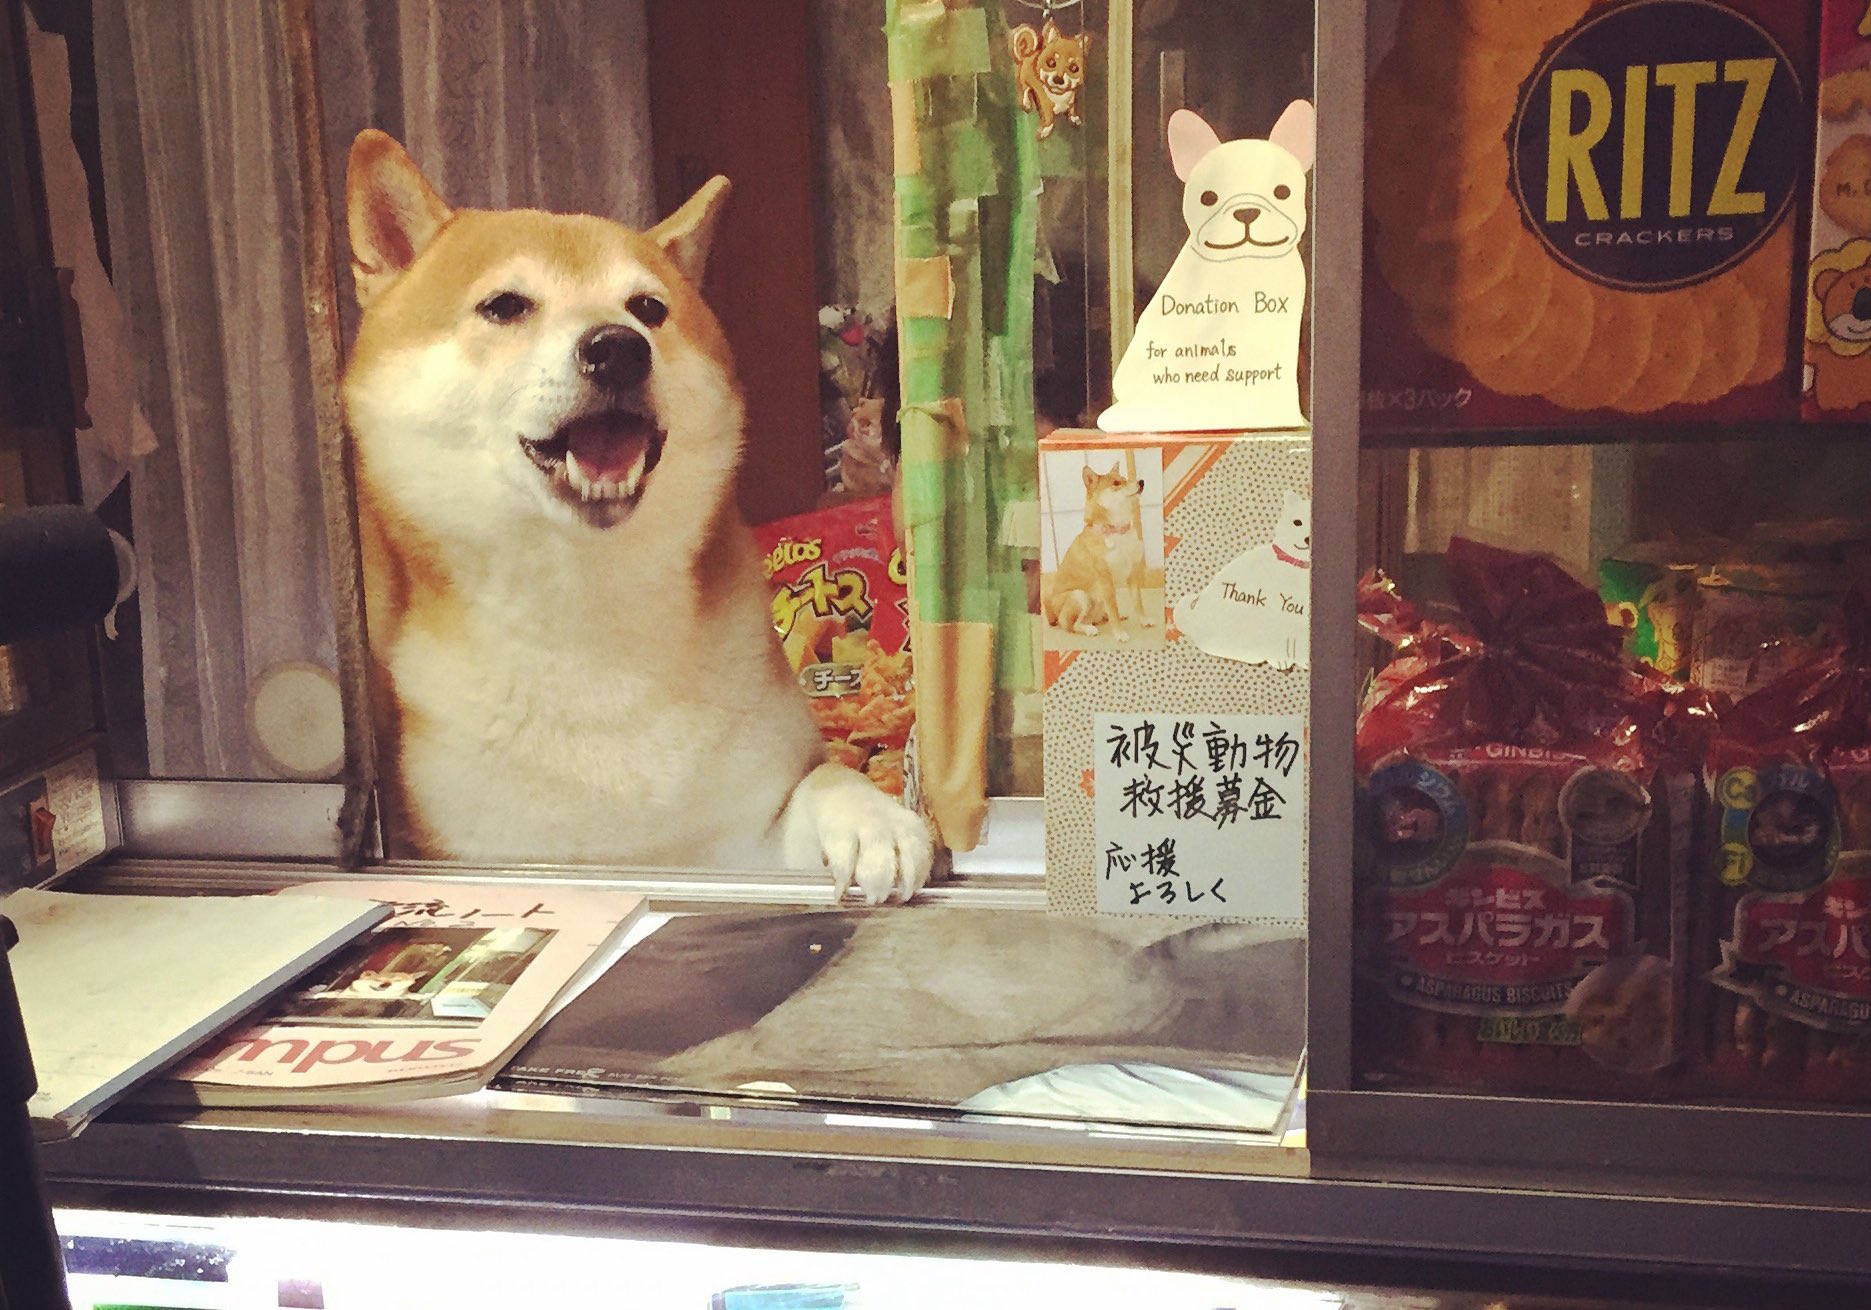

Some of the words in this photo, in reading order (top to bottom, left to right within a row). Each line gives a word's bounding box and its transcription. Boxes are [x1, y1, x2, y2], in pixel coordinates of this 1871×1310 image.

[1546, 57, 1776, 223] RITZ
[1574, 226, 1735, 247] CRACKERS
[1161, 293, 1240, 317] Donation
[1254, 291, 1289, 314] Box
[1146, 341, 1167, 360] for
[1175, 338, 1237, 359] animals
[1153, 367, 1180, 385] who
[1186, 364, 1220, 384] need
[1225, 363, 1283, 387] support
[1222, 582, 1268, 608] Thank
[1279, 592, 1305, 616] You
[1106, 720, 1300, 778] 被災動物
[1119, 774, 1287, 830] 救援募金
[1105, 837, 1181, 880] 応援
[1129, 877, 1228, 905] よろしく
[1385, 910, 1611, 950] アスパラガス
[1415, 975, 1501, 1003] ASPARAGUS
